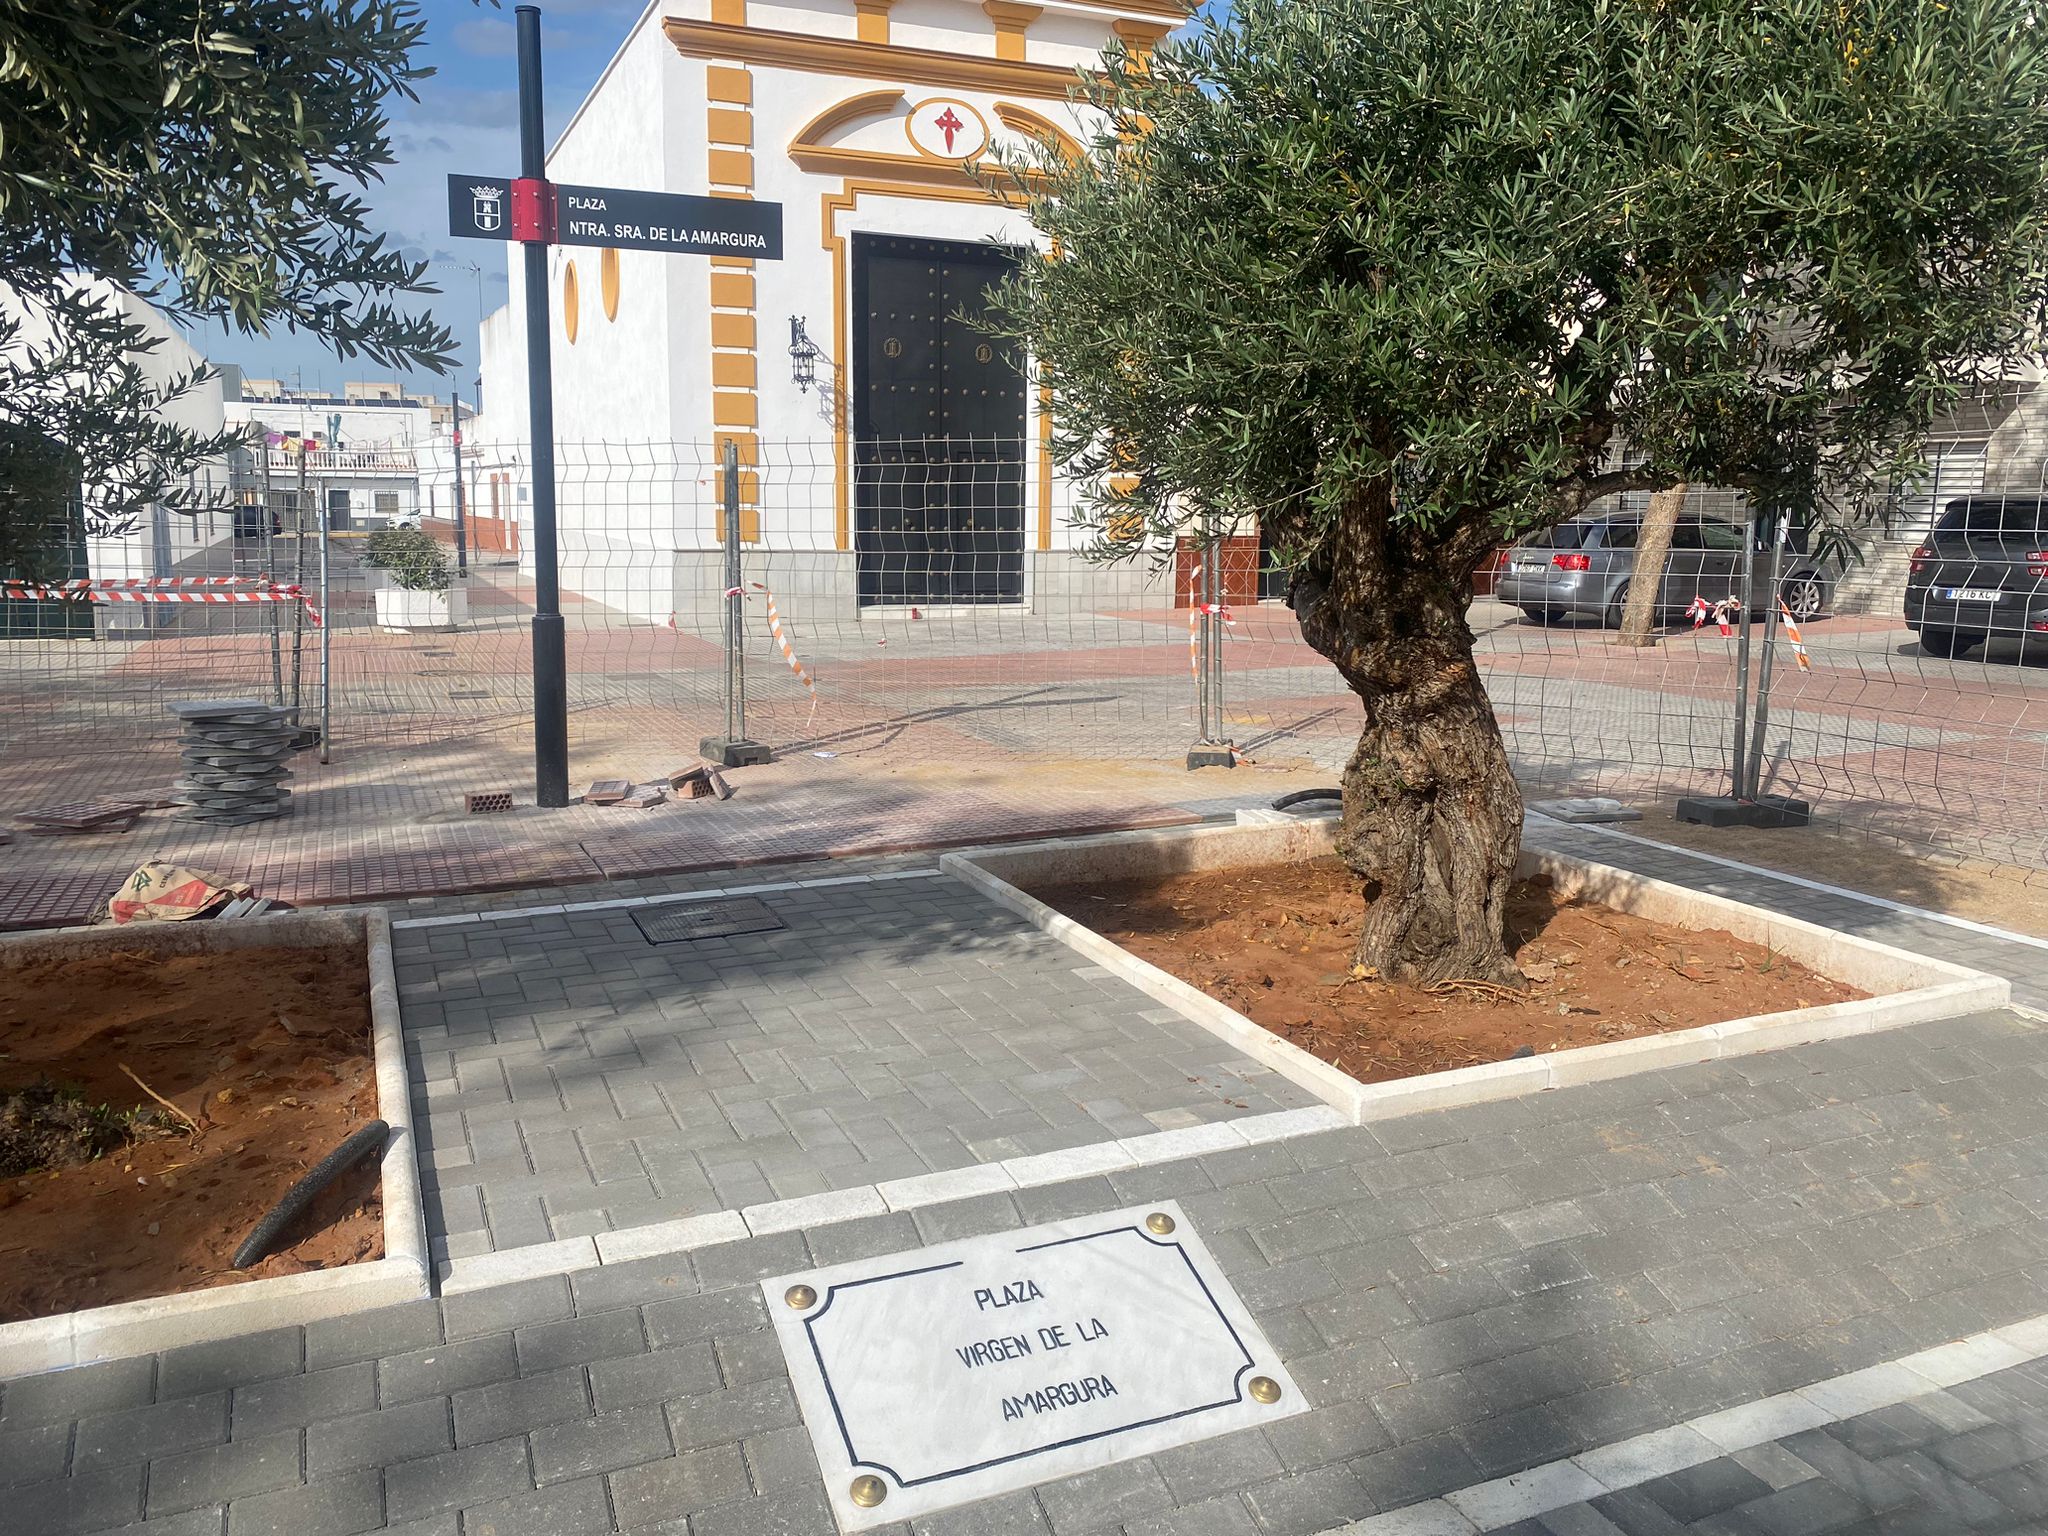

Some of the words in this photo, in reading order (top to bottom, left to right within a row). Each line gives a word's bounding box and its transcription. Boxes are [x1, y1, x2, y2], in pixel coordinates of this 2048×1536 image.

[568, 196, 607, 211] PLAZA
[569, 220, 611, 237] NTRA.
[614, 224, 646, 240] SRA.
[649, 226, 668, 241] DE
[671, 228, 689, 243] LA
[690, 229, 767, 249] AMARGURA
[974, 1279, 1045, 1311] PLAZA
[955, 1334, 1032, 1368] VIRGEN
[1037, 1325, 1072, 1351] DE
[1075, 1317, 1109, 1342] LA
[1001, 1374, 1119, 1422] AMARGURA
